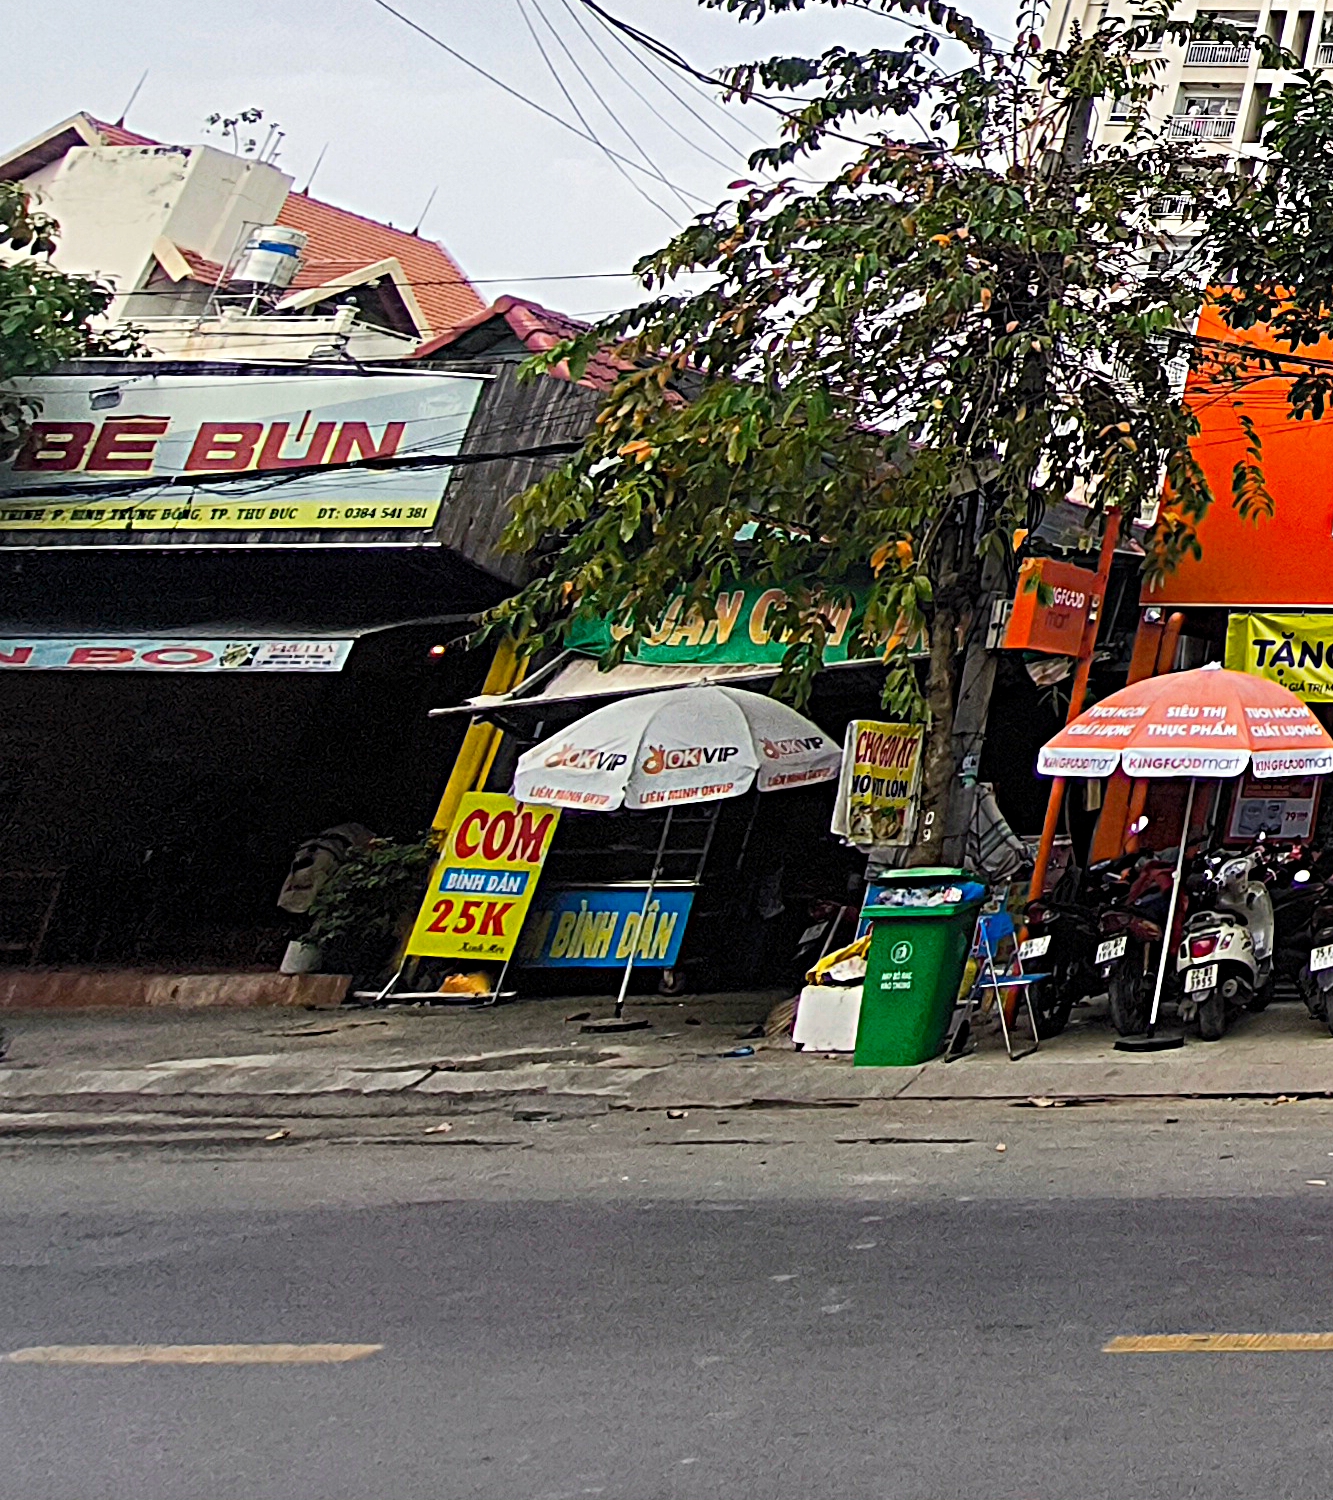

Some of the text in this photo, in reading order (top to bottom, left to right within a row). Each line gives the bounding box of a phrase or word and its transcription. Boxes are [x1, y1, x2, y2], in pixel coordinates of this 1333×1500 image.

[184, 410, 407, 471] BÚN
[344, 507, 378, 520] 0384
[380, 507, 402, 520] 541
[406, 507, 428, 520] 381
[1166, 704, 1227, 719] SIÊU THỊ
[1274, 706, 1310, 718] NGON
[1147, 723, 1188, 738] THỰC
[1128, 756, 1241, 771] KINGFOODmart
[454, 802, 555, 864] CƠM
[446, 868, 521, 893] BÌNH DÂN
[426, 899, 516, 937] 25K
[549, 899, 619, 960] BÌNH
[616, 899, 678, 960] DÂN
